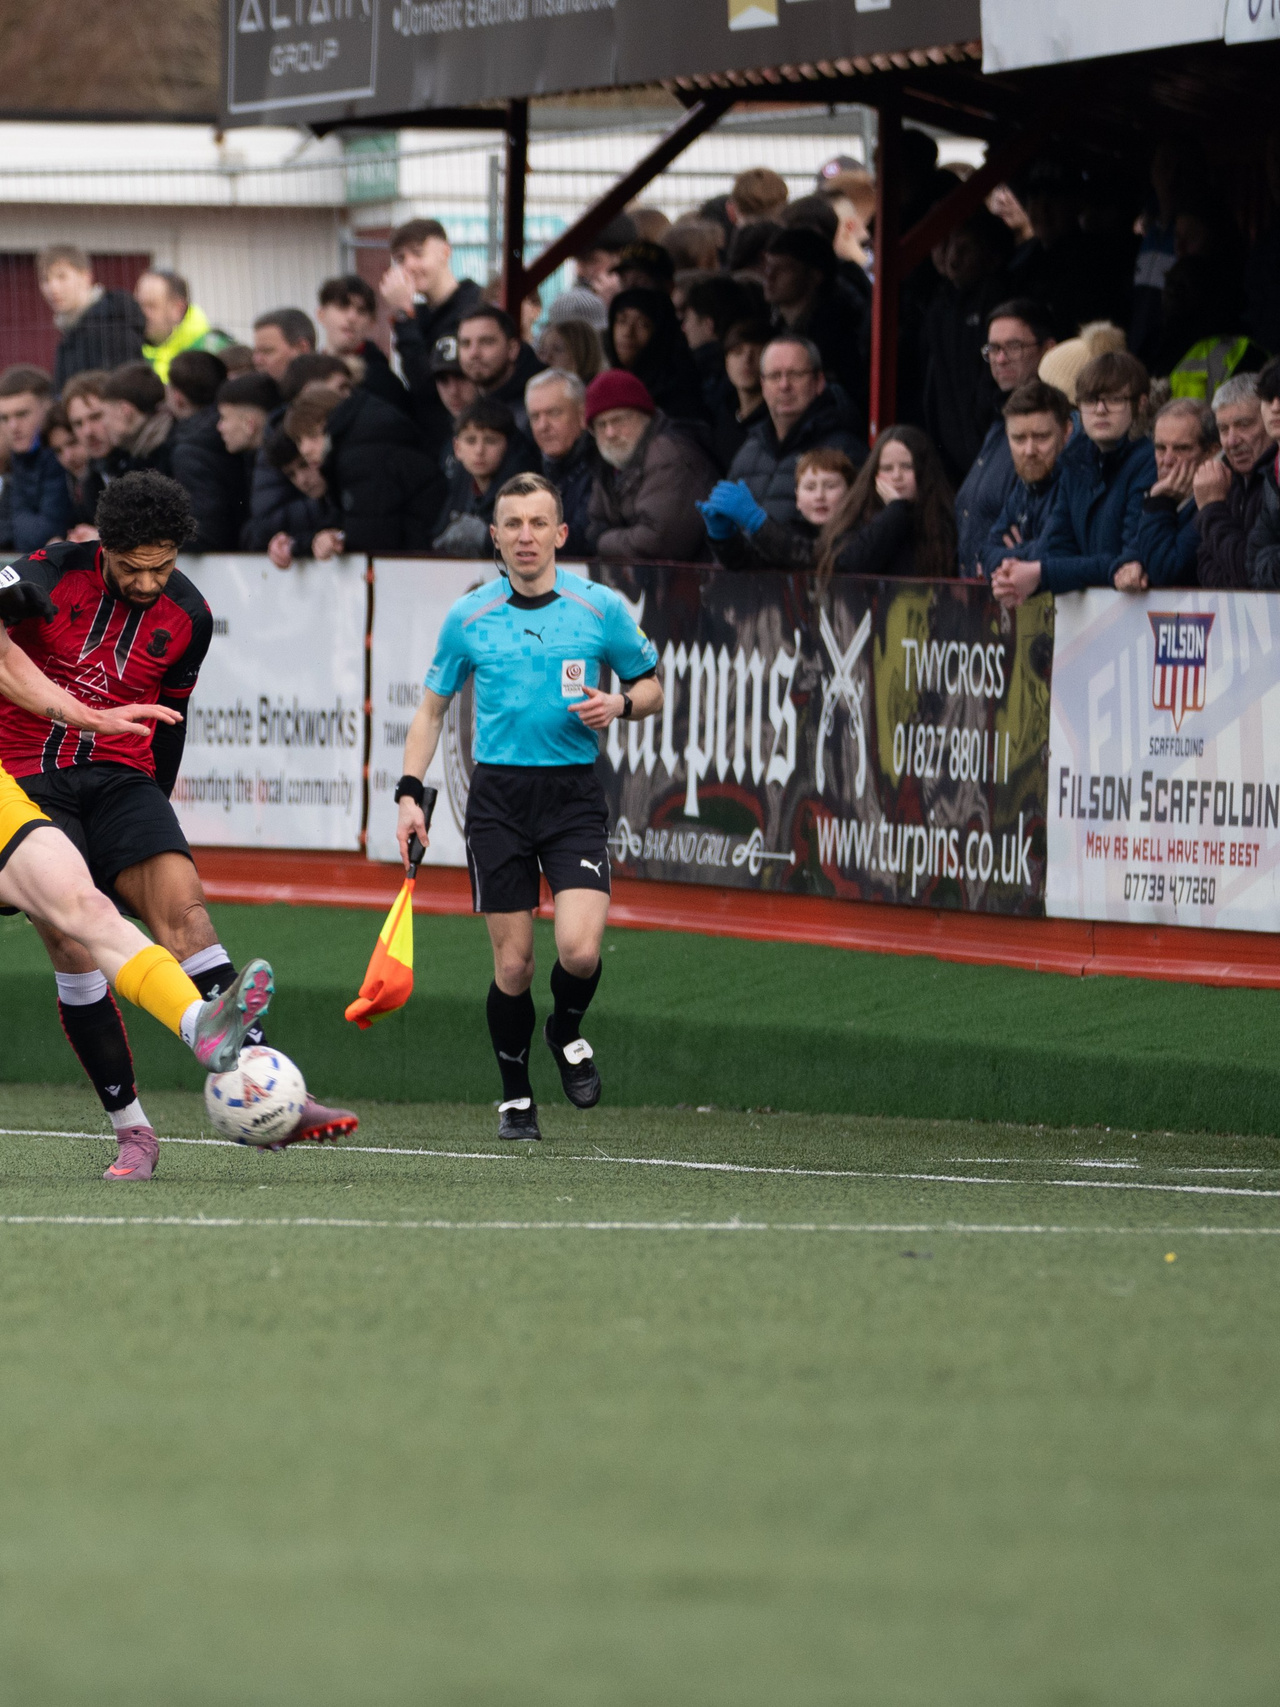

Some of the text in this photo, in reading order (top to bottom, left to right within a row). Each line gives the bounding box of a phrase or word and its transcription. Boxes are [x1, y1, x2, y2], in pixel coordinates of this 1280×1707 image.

[270, 38, 339, 77] GROUP
[1158, 623, 1205, 660] FILSON
[901, 637, 1006, 699] TWYCROSS
[258, 695, 357, 747] Brickworks
[892, 722, 1010, 785] 01827 880111
[1149, 737, 1204, 758] SCAFFOLDING
[235, 770, 253, 804] the
[255, 769, 284, 805] local
[287, 770, 353, 815] community
[1140, 770, 1280, 829] SCAFFOLDIN
[643, 827, 731, 867] BAR AND GRILL
[816, 808, 1033, 897] www.turpins.co.uk
[1114, 836, 1128, 861] AS
[1132, 838, 1163, 863] WELL
[1167, 839, 1199, 865] HAVE
[1203, 841, 1226, 866] THE
[1229, 843, 1260, 868] BEST
[1124, 872, 1216, 905] 07739 477260
